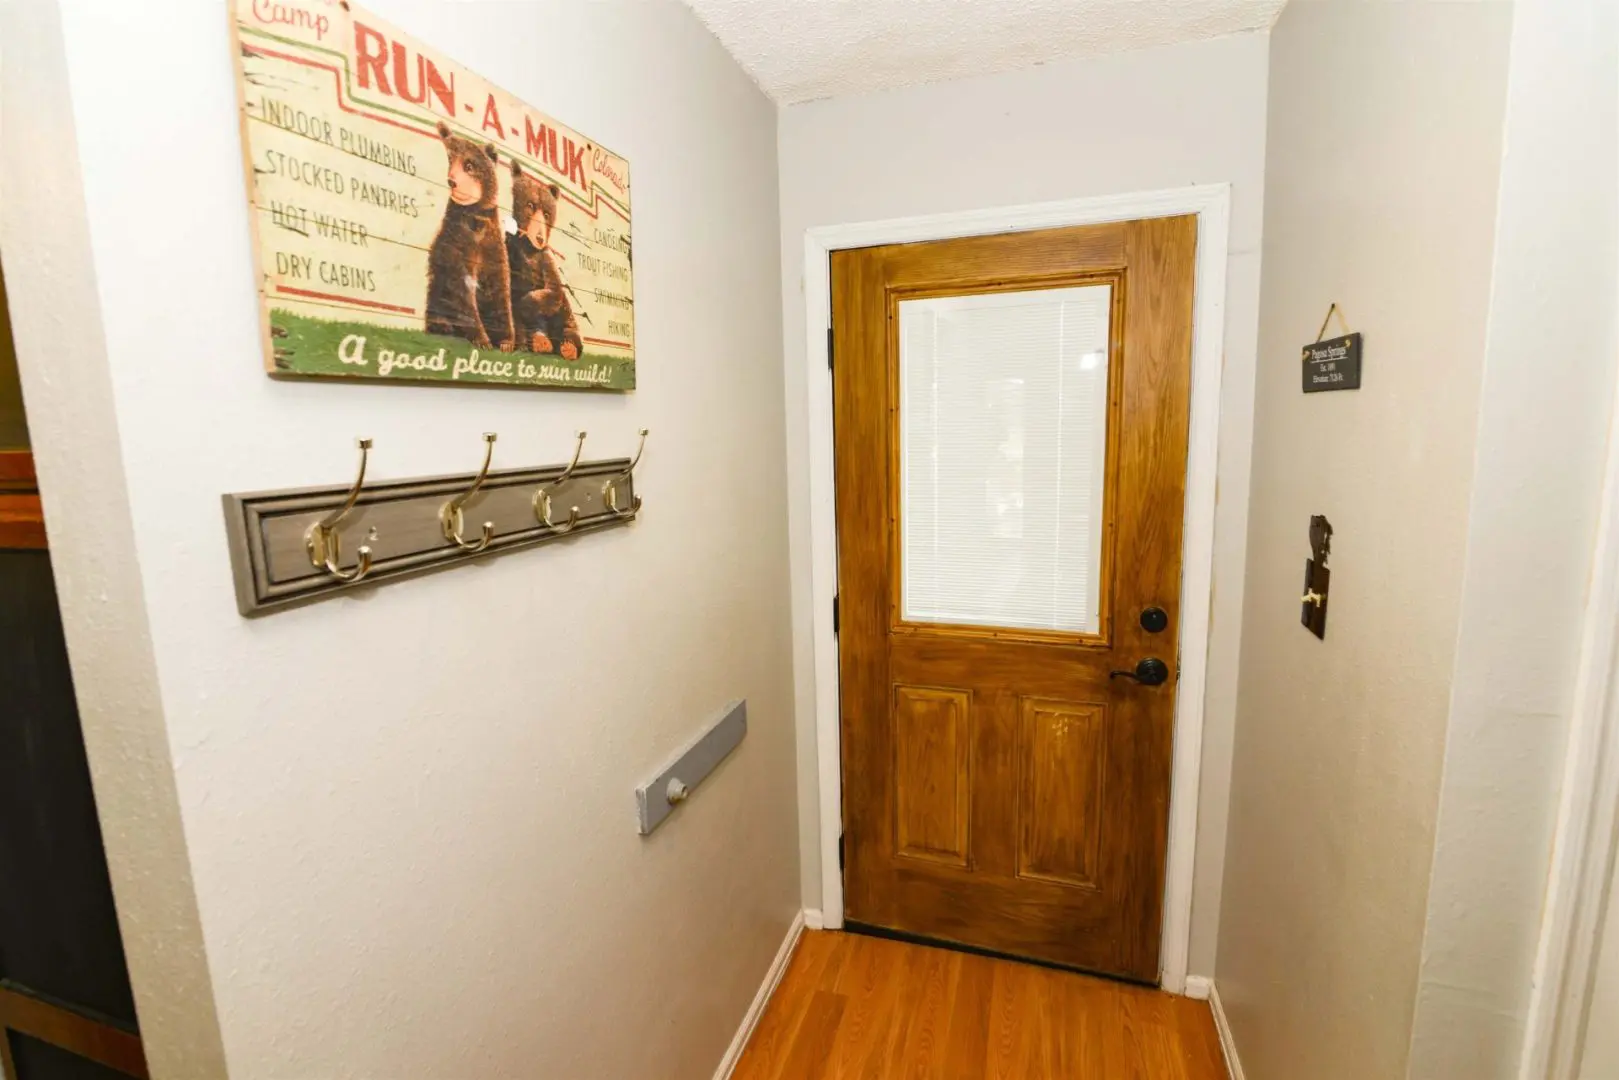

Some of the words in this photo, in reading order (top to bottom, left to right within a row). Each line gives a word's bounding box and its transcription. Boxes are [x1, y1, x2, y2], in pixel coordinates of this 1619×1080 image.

[252, 0, 329, 41] Camp
[261, 96, 334, 147] INDOOR
[340, 127, 418, 176] PLUMBING
[265, 149, 345, 195] STOCKED
[351, 177, 419, 218] PANTRIES
[271, 200, 308, 233] HOT
[313, 211, 369, 248] WATER
[276, 252, 313, 280] DRY
[319, 260, 376, 292] CABINS
[577, 252, 601, 275] TROUT
[602, 260, 629, 283] FISHING
[608, 320, 630, 338] HIKING
[377, 348, 448, 376] good
[452, 349, 513, 379] place
[518, 358, 537, 379] to
[537, 366, 571, 382] run
[574, 363, 612, 383] wild!
